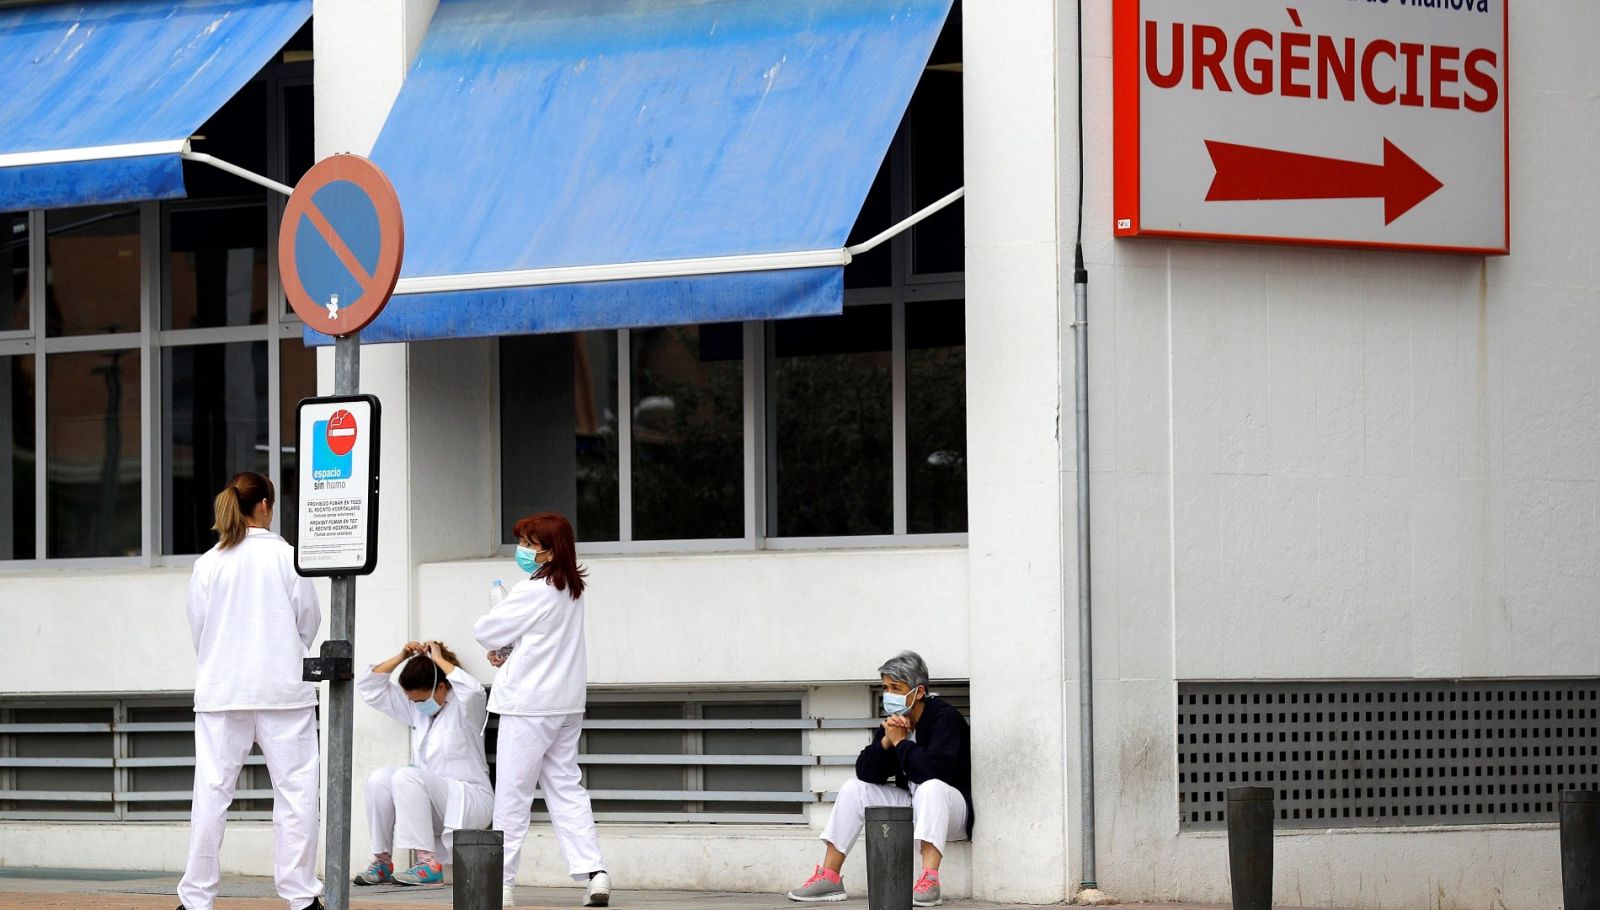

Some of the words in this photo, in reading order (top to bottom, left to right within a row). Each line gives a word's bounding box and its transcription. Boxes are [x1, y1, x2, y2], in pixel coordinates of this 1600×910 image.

[1145, 8, 1499, 113] URGÈNCIES
[314, 467, 341, 479] espacio
[326, 480, 346, 489] humo
